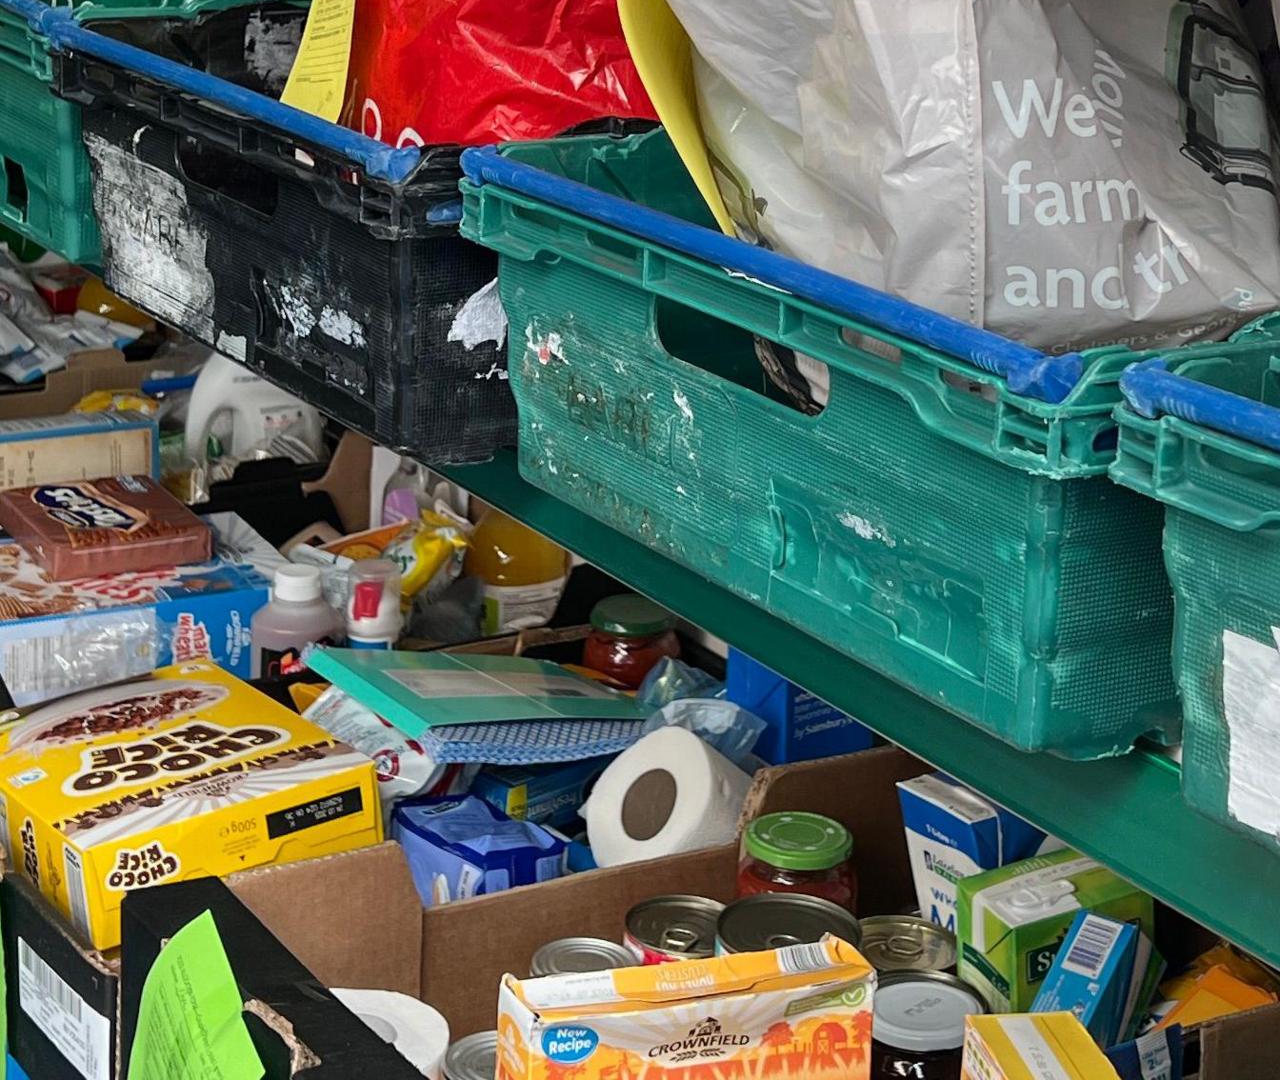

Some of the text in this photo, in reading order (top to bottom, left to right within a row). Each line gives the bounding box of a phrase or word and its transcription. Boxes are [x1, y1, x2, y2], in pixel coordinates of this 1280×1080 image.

[73, 728, 282, 791] CHOCO
[231, 818, 257, 833] 500g
[109, 857, 178, 887] CHOCO
[555, 1027, 587, 1040] New
[548, 1037, 592, 1056] Recipe
[647, 1034, 751, 1059] CROWNFIELD
